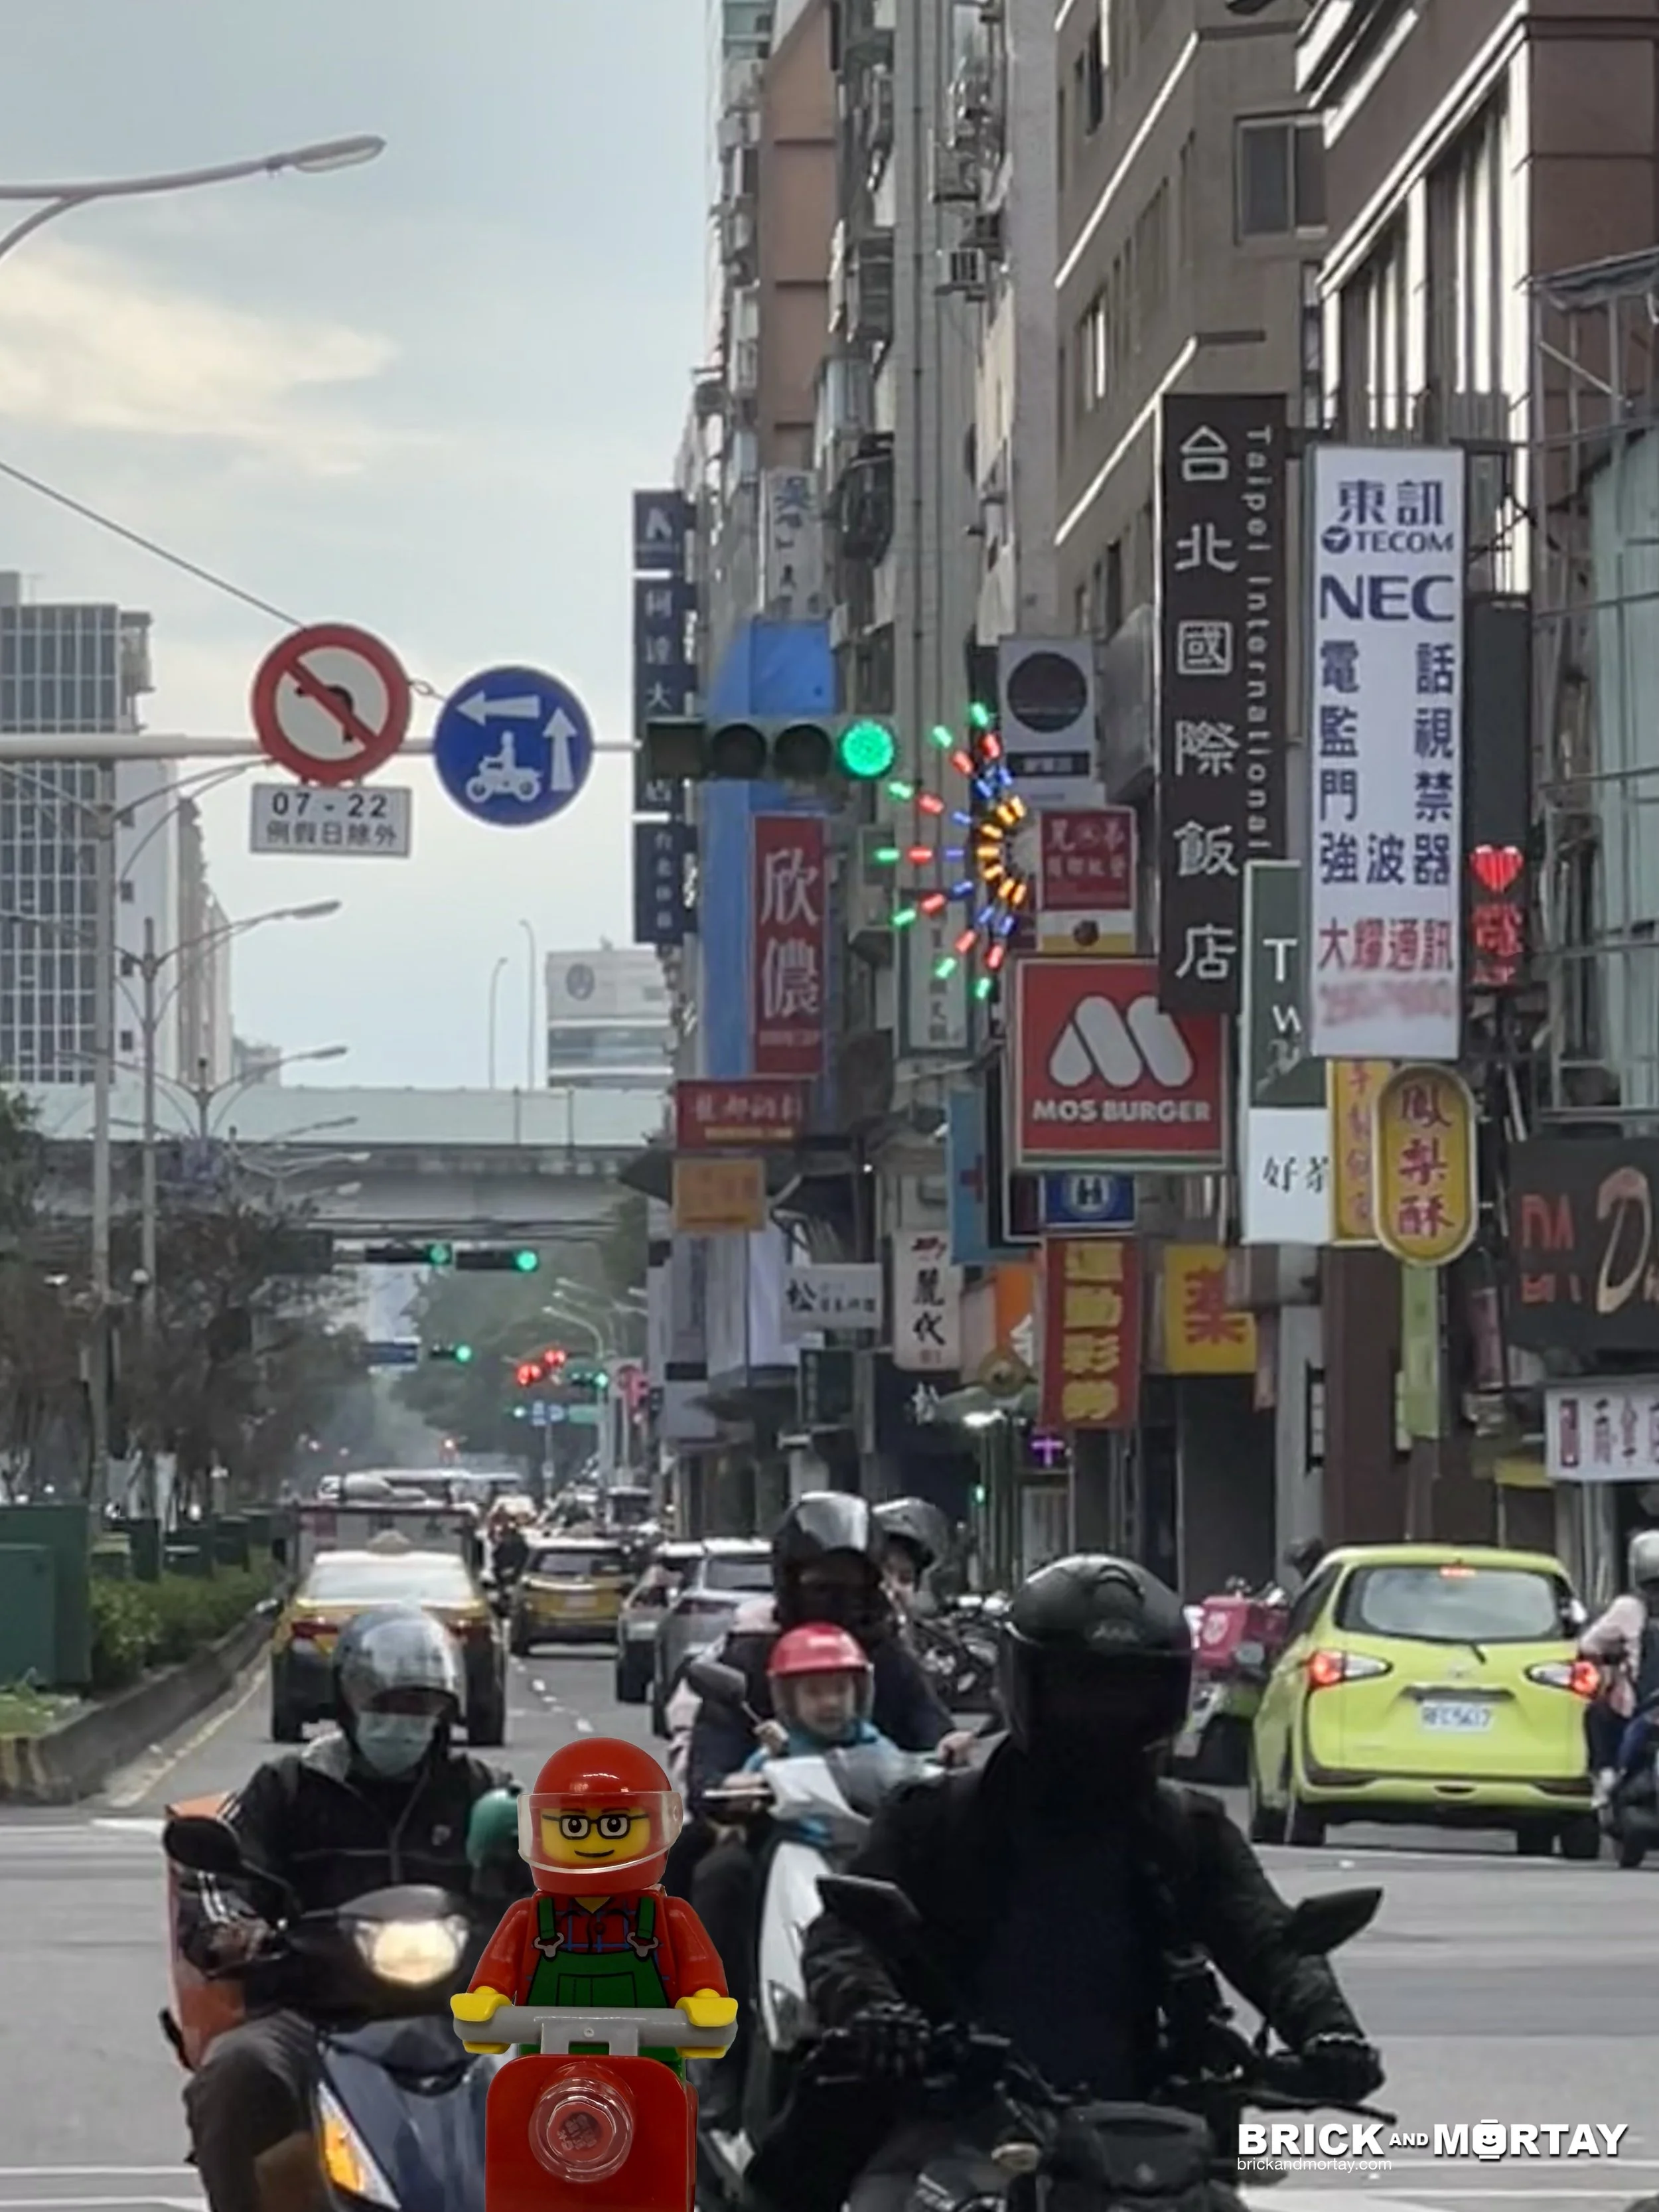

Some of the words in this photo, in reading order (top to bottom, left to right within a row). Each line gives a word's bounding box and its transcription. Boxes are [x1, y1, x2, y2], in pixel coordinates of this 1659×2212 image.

[1242, 425, 1272, 550] Taipei
[1338, 479, 1444, 526] 東訊
[1357, 531, 1454, 553] TECOM
[1320, 574, 1455, 622] NEC
[1173, 425, 1240, 980] 台北國際飯店
[1247, 577, 1272, 849] International
[1319, 832, 1451, 886] 強波器
[1032, 1099, 1098, 1122] MOS
[1102, 1099, 1211, 1122] BURGER
[1398, 1082, 1456, 1239] 鳳梨酥
